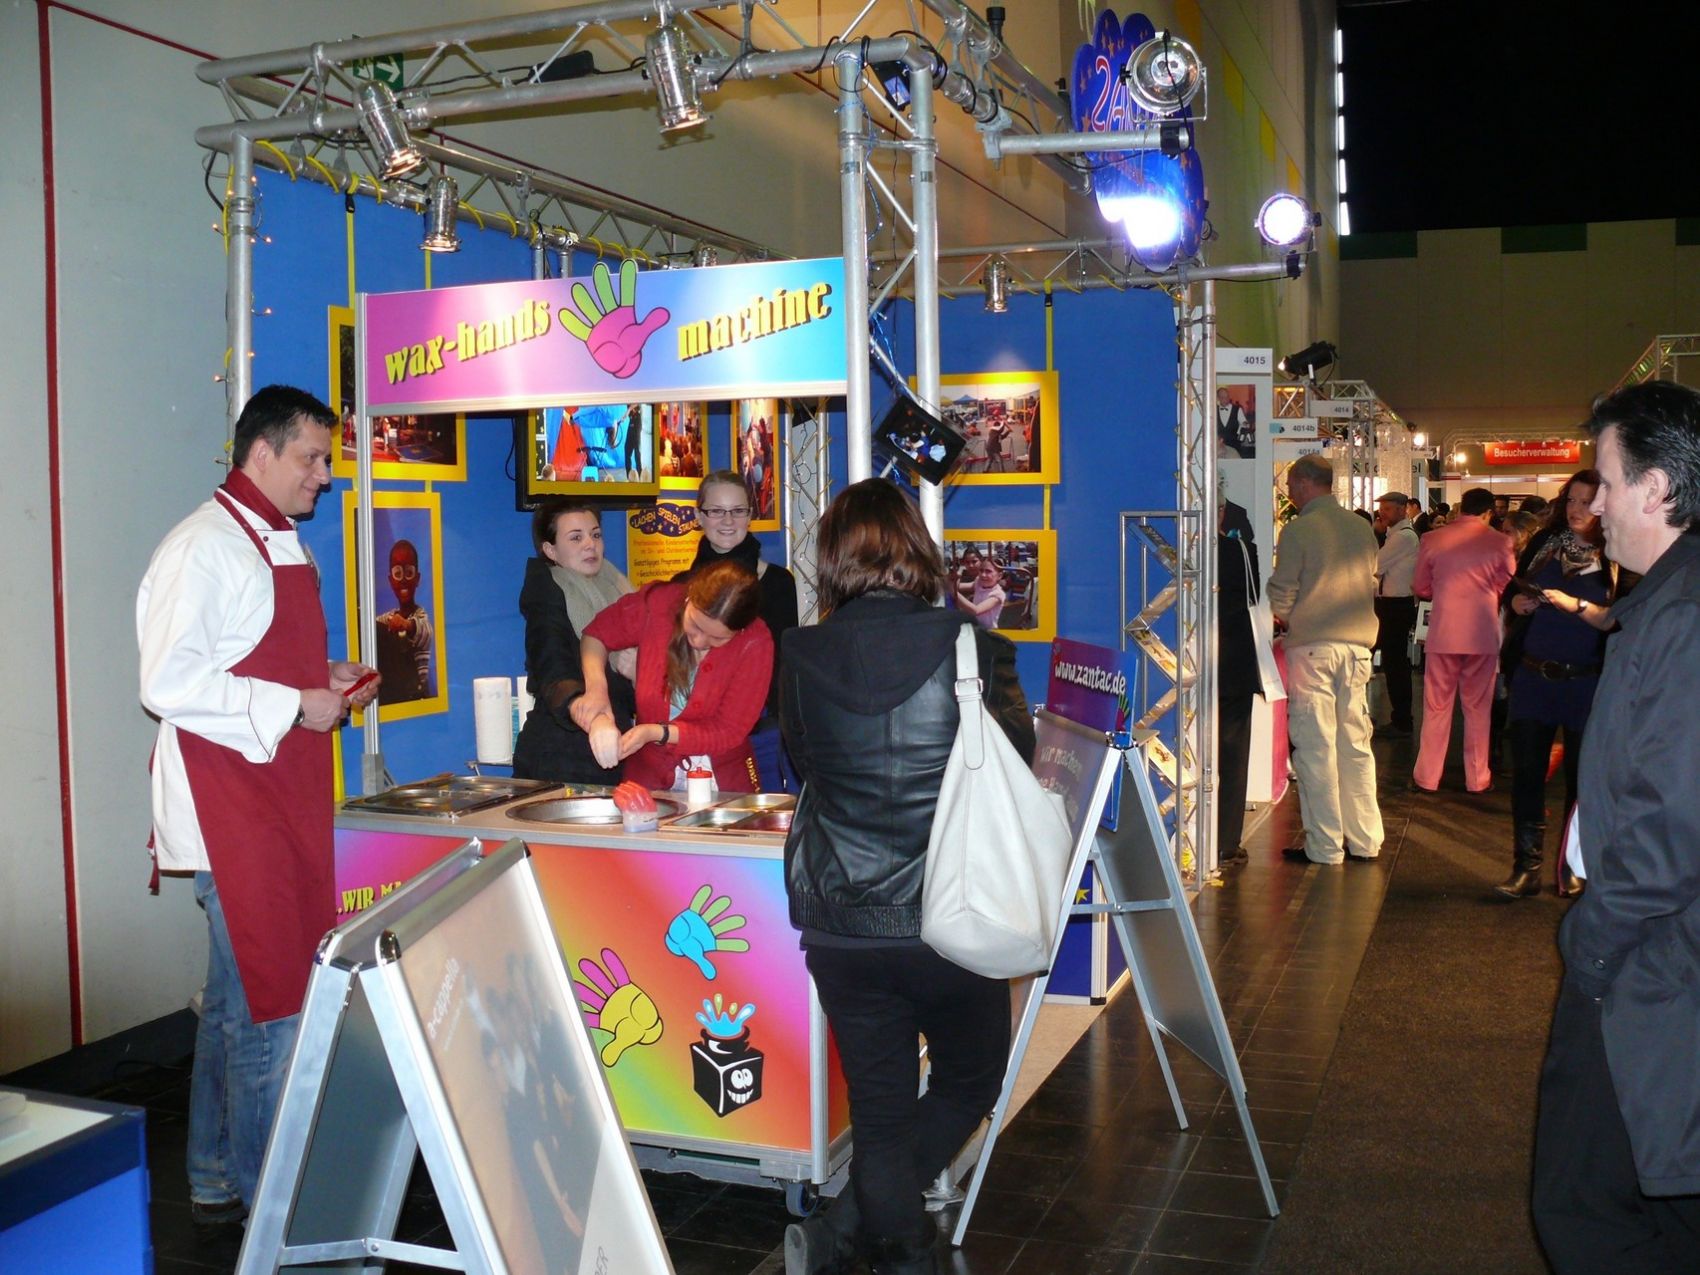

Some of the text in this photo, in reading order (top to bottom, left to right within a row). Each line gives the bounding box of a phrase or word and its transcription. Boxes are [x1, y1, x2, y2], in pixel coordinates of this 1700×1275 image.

[384, 282, 833, 385] wax-hands machine
[1243, 356, 1266, 365] 4015
[1292, 424, 1315, 432] 4014b
[1493, 447, 1571, 458] Besucherverwaltung
[1054, 660, 1126, 695] www.zantac.de
